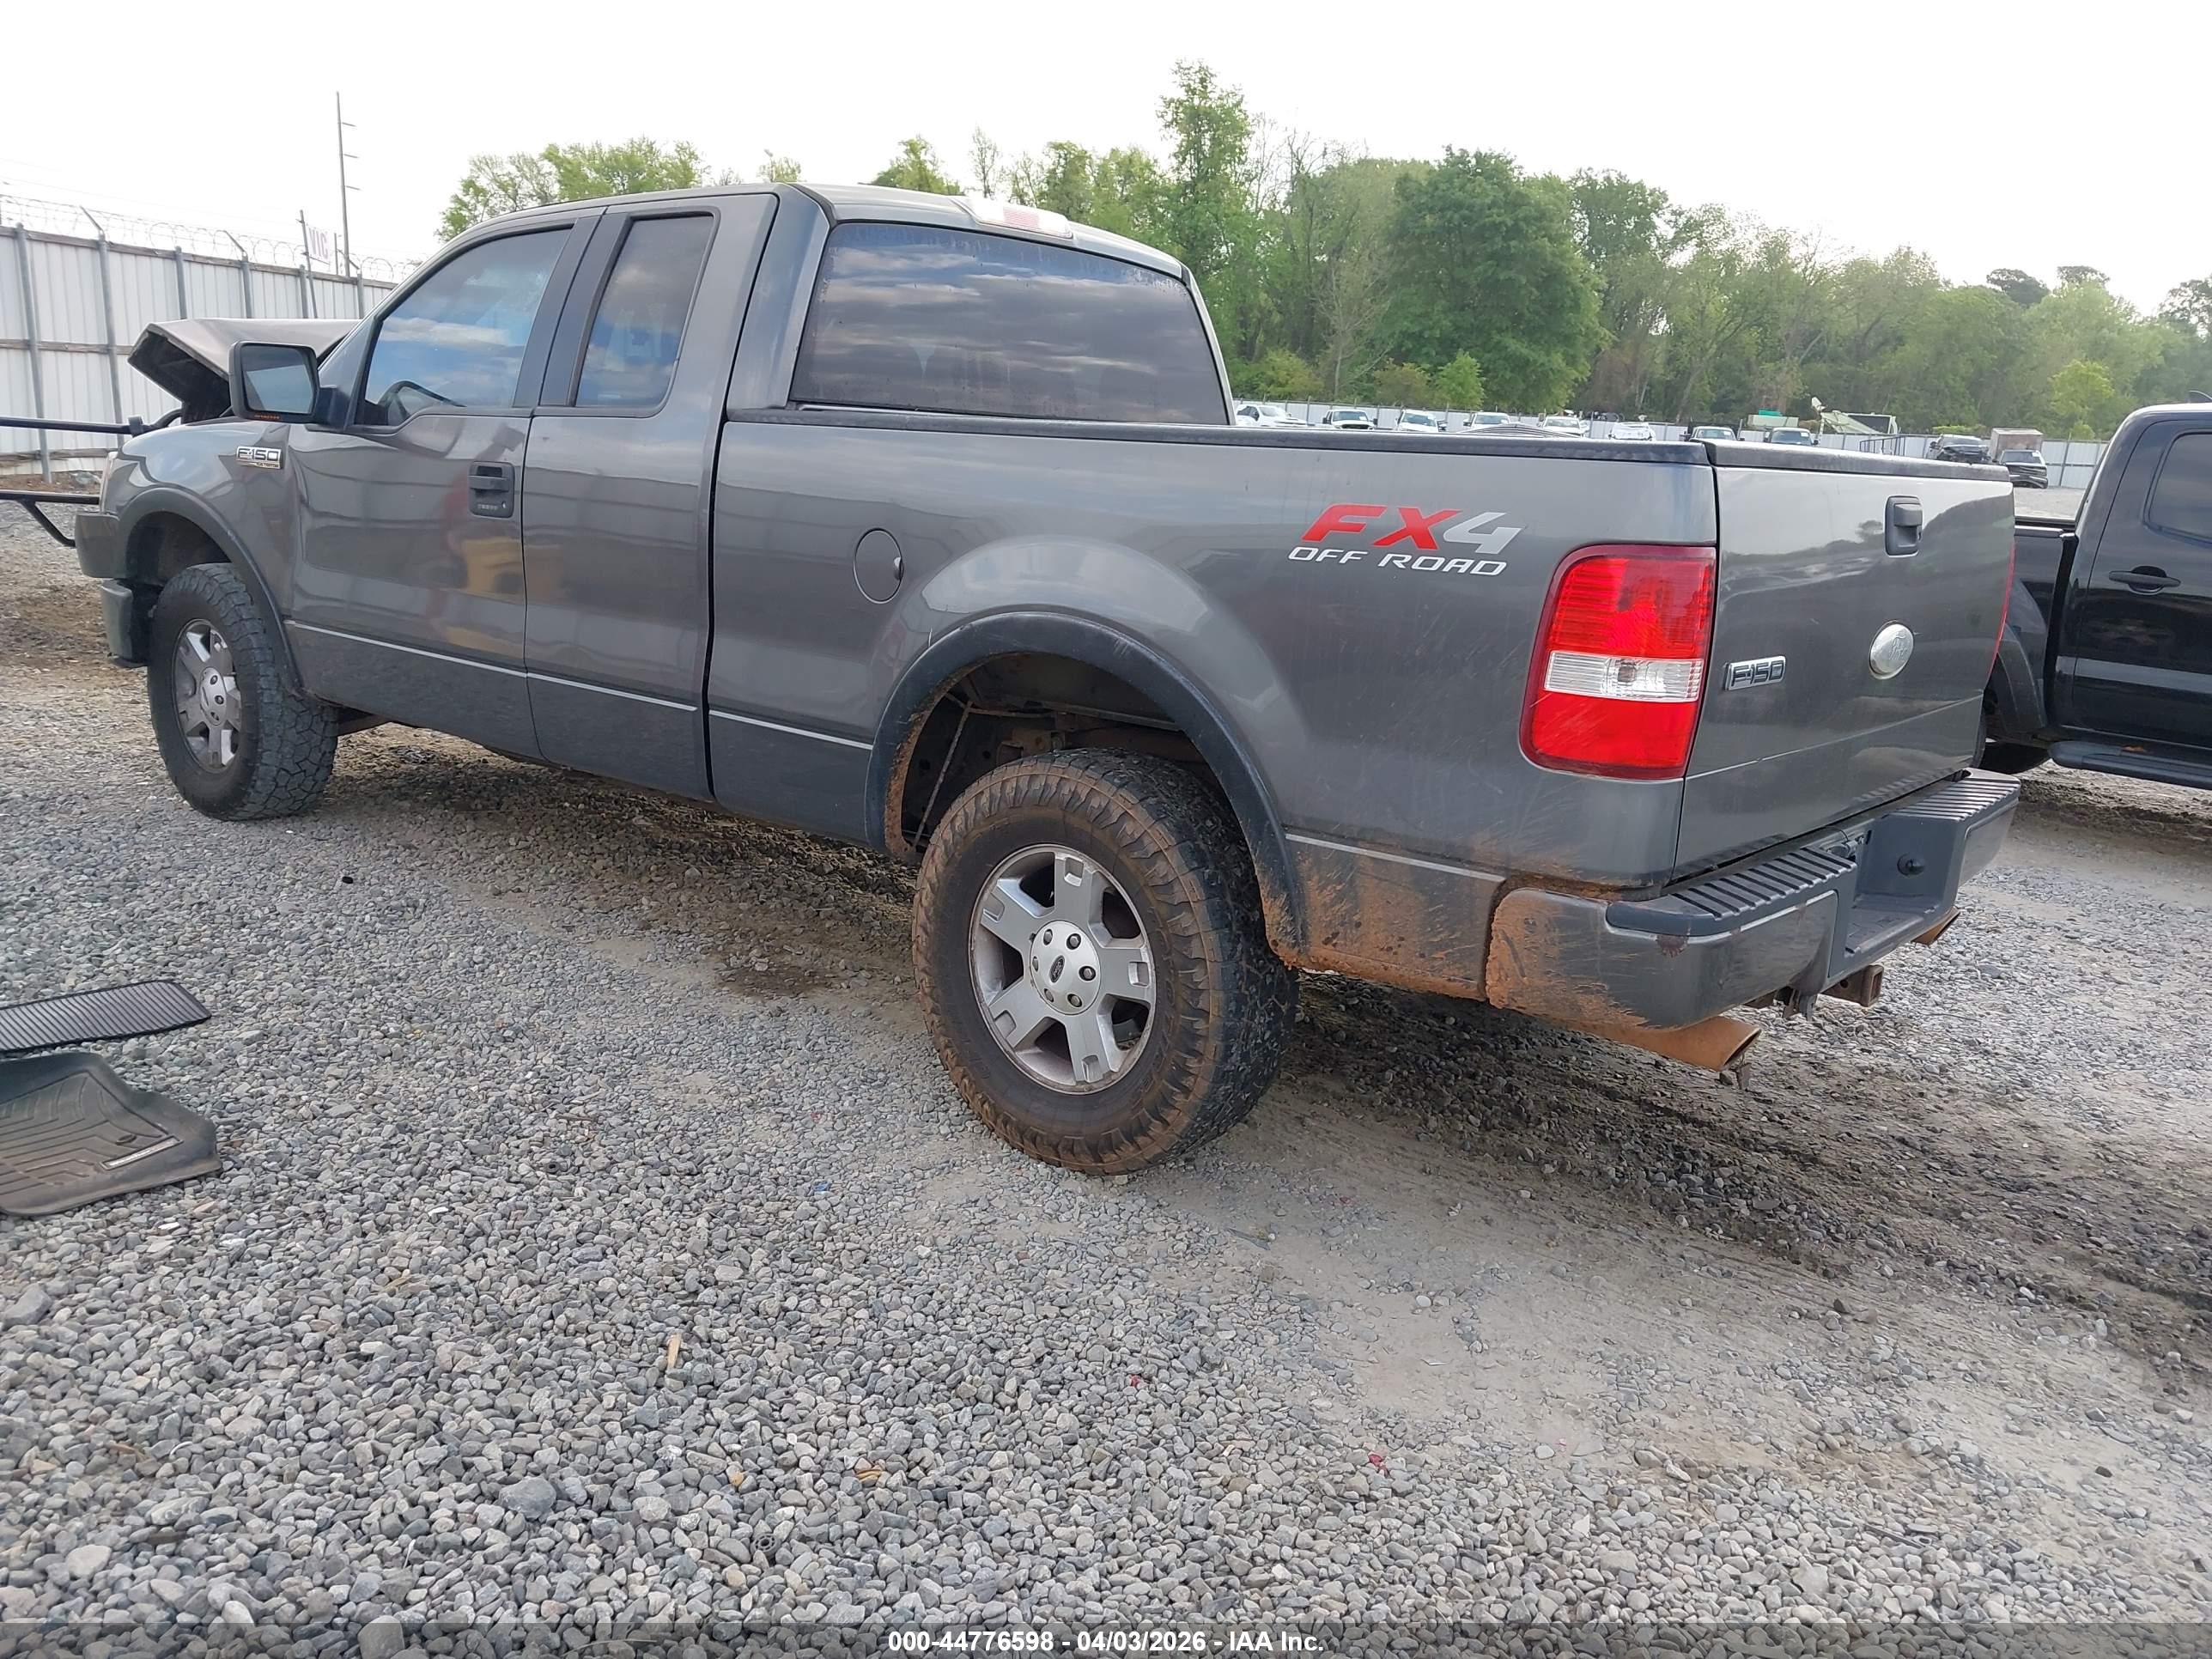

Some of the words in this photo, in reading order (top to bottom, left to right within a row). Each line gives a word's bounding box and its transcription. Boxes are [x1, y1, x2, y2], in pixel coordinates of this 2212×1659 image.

[1300, 502, 1525, 555] FX4
[1287, 545, 1369, 564] OFF
[1376, 552, 1508, 577] ROAD
[1730, 659, 1784, 687] F-150
